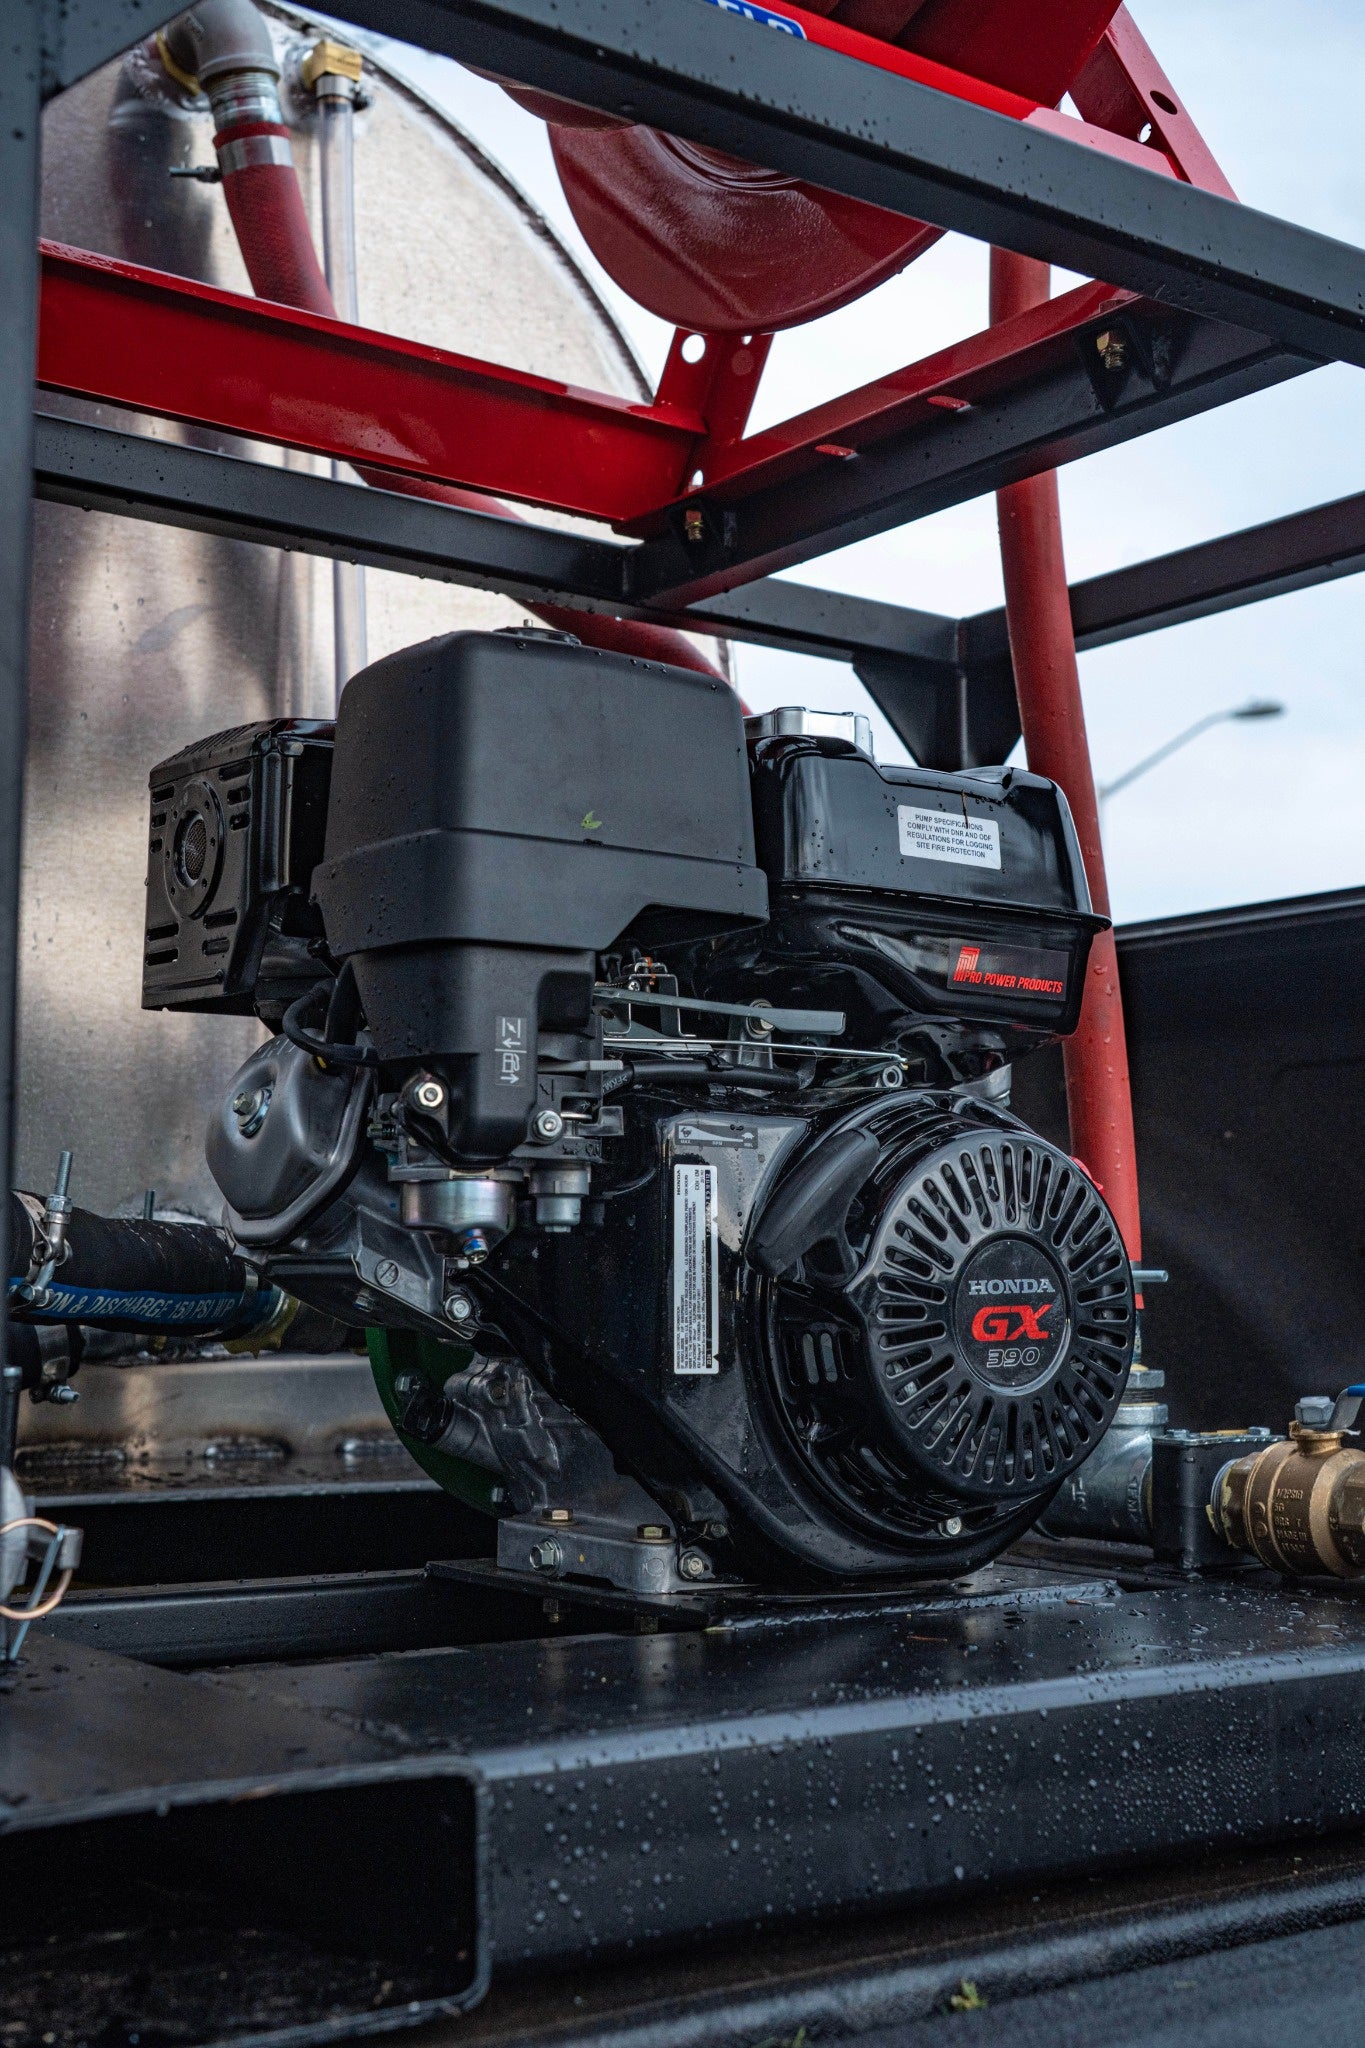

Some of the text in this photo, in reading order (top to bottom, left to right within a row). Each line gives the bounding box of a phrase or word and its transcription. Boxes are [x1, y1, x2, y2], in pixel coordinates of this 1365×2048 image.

[907, 822, 933, 832] COMPLY
[934, 826, 950, 834] WITH
[965, 831, 978, 840] AND
[915, 814, 983, 831] PUMP SPECIFICAIONS
[907, 831, 993, 850] REGULATIONS FOR LOGGING
[916, 842, 986, 858] SITE FIRE PROTECTION
[962, 971, 1063, 994] PRO POWER PRODUCTS
[968, 1278, 1056, 1295] HONDA
[68, 1296, 88, 1314] &
[85, 1296, 173, 1318] DISCHARGE
[971, 1304, 1053, 1342] GX
[986, 1346, 1040, 1368] 390
